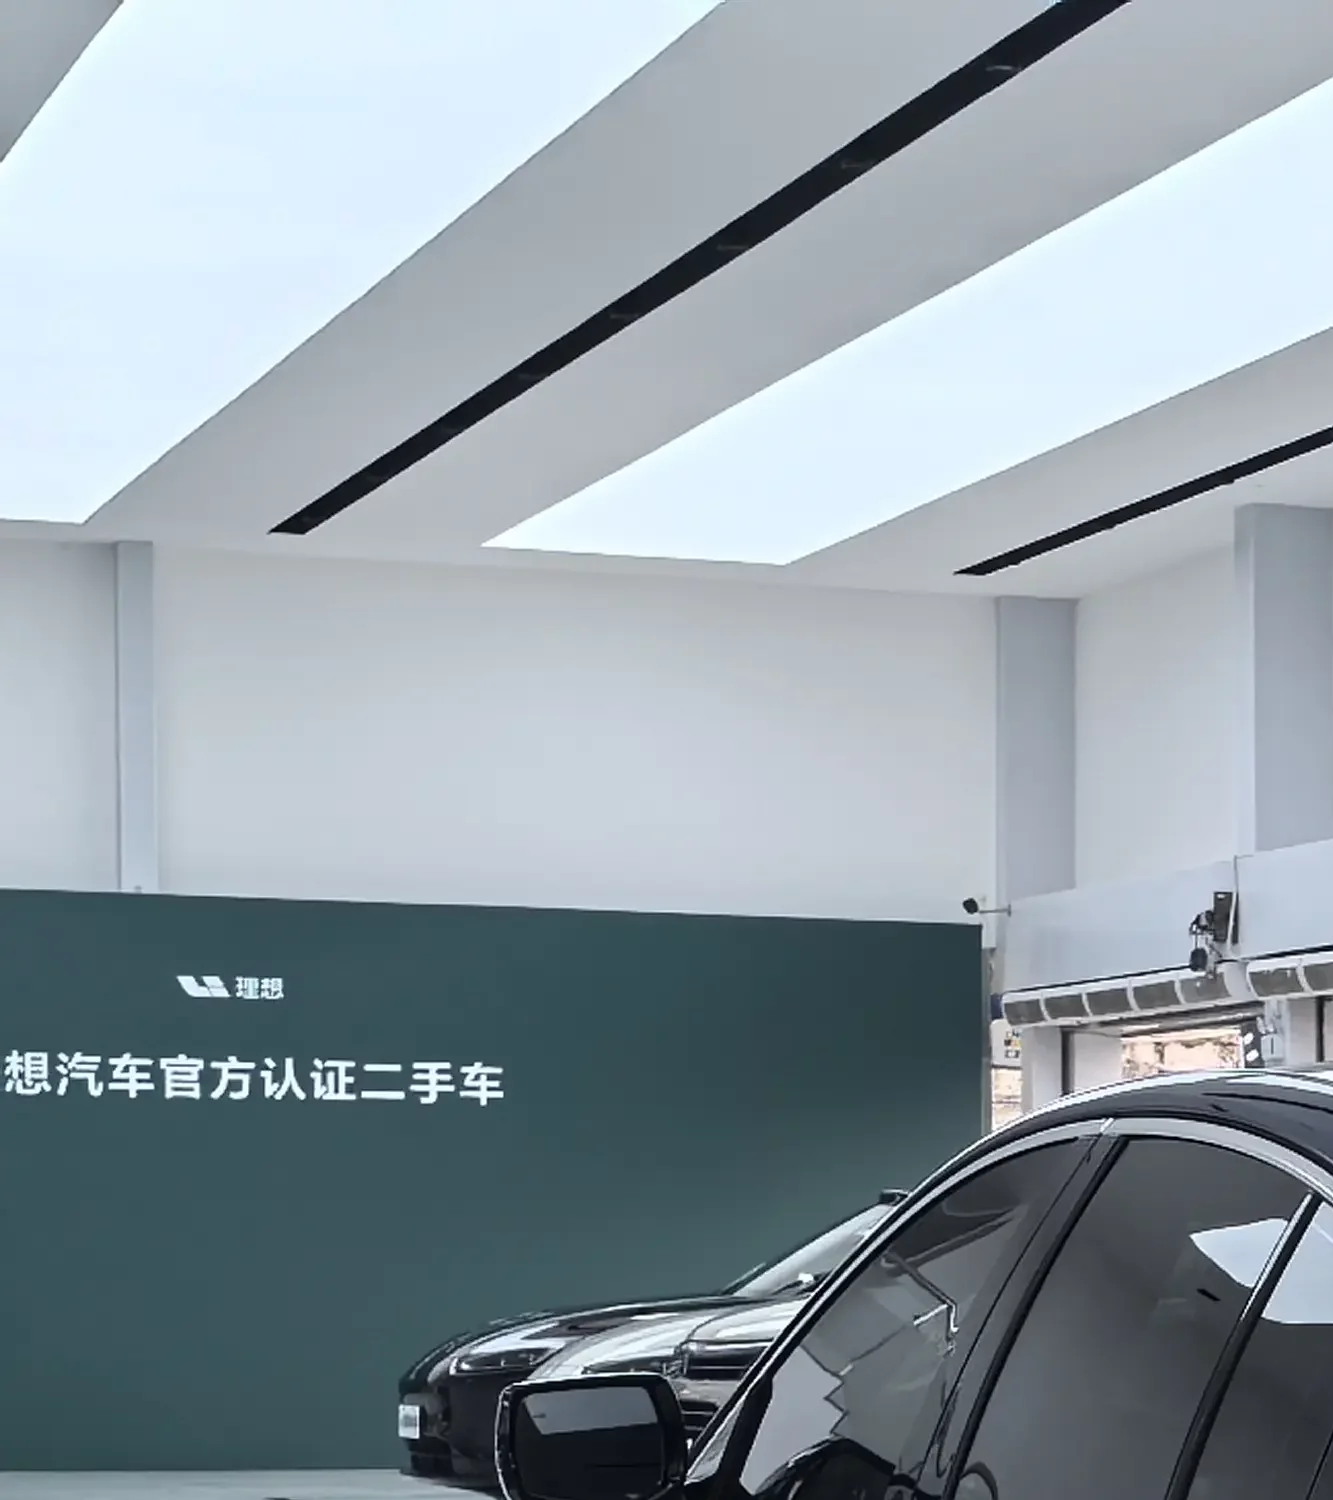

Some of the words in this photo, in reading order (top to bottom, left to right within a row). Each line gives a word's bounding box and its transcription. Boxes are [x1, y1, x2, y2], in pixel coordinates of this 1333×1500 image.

[235, 976, 284, 999] 理想
[4, 1050, 504, 1106] 想汽车官方认证二手车
